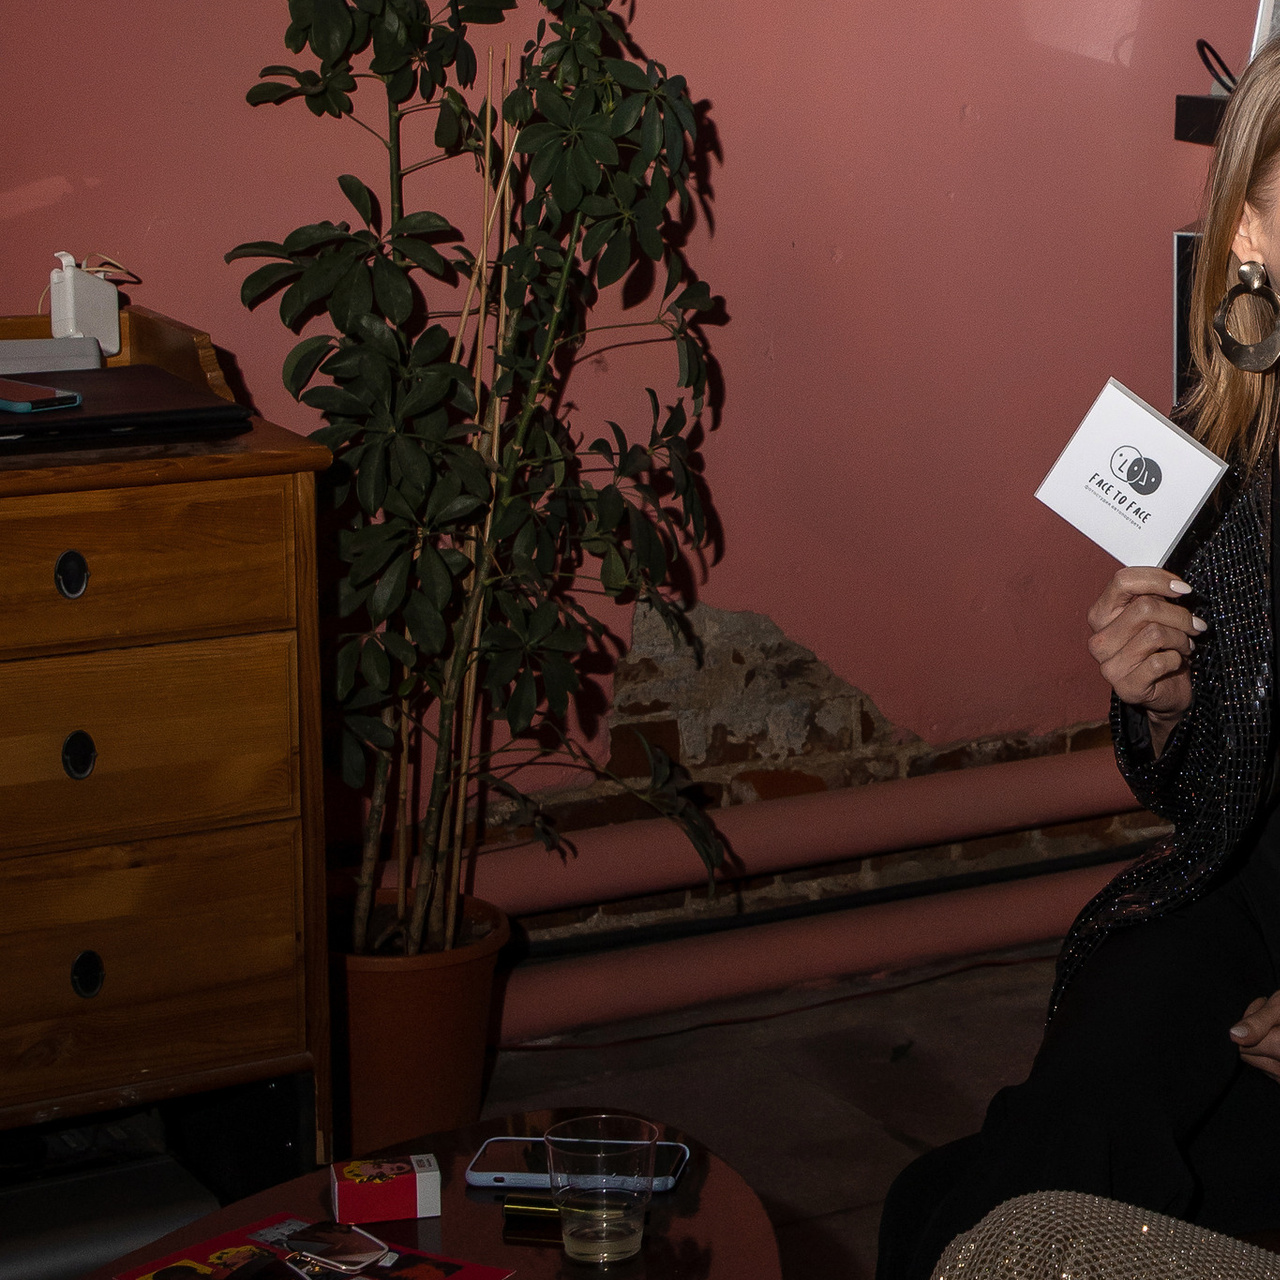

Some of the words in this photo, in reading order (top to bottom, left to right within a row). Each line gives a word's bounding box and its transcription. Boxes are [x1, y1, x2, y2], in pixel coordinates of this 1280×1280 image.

[1088, 472, 1114, 495] FACE
[1113, 490, 1127, 505] TO
[1125, 501, 1151, 523] FACE
